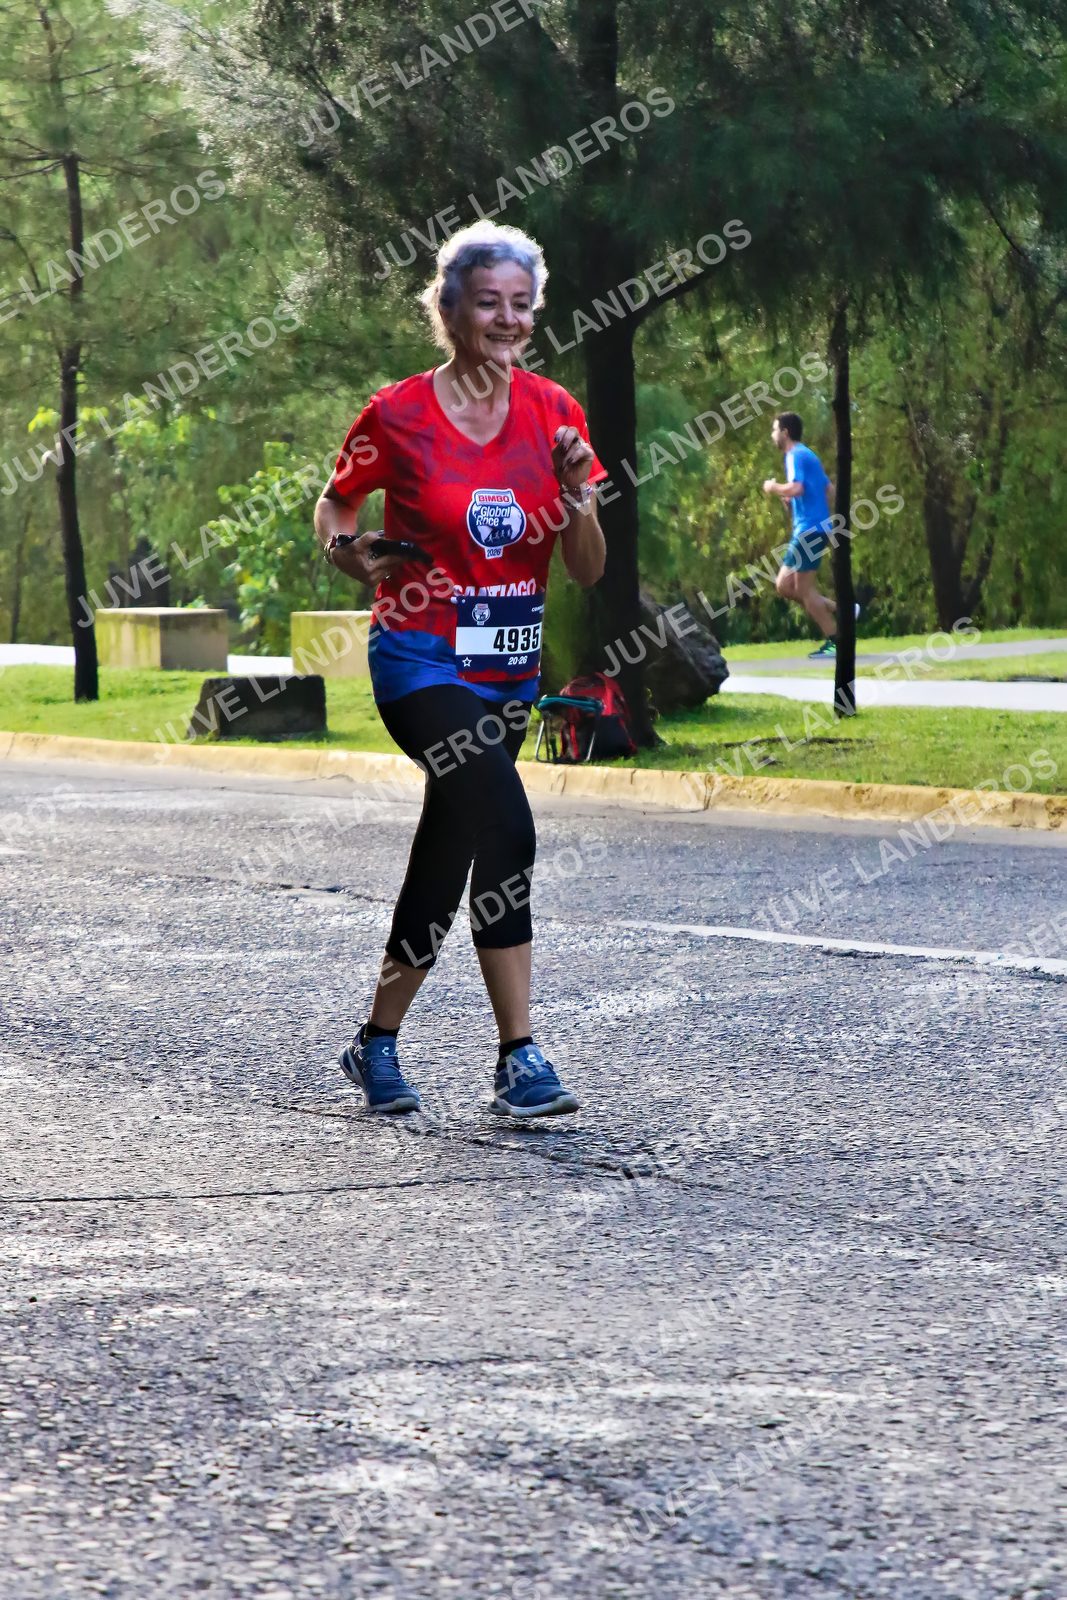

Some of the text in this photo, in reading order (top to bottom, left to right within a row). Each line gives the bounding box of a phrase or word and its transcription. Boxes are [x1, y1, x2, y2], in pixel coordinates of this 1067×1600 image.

[478, 494, 510, 503] BIMBO
[480, 505, 511, 518] Global
[476, 514, 500, 527] Race
[486, 548, 502, 558] 2026
[493, 624, 540, 653] 4935
